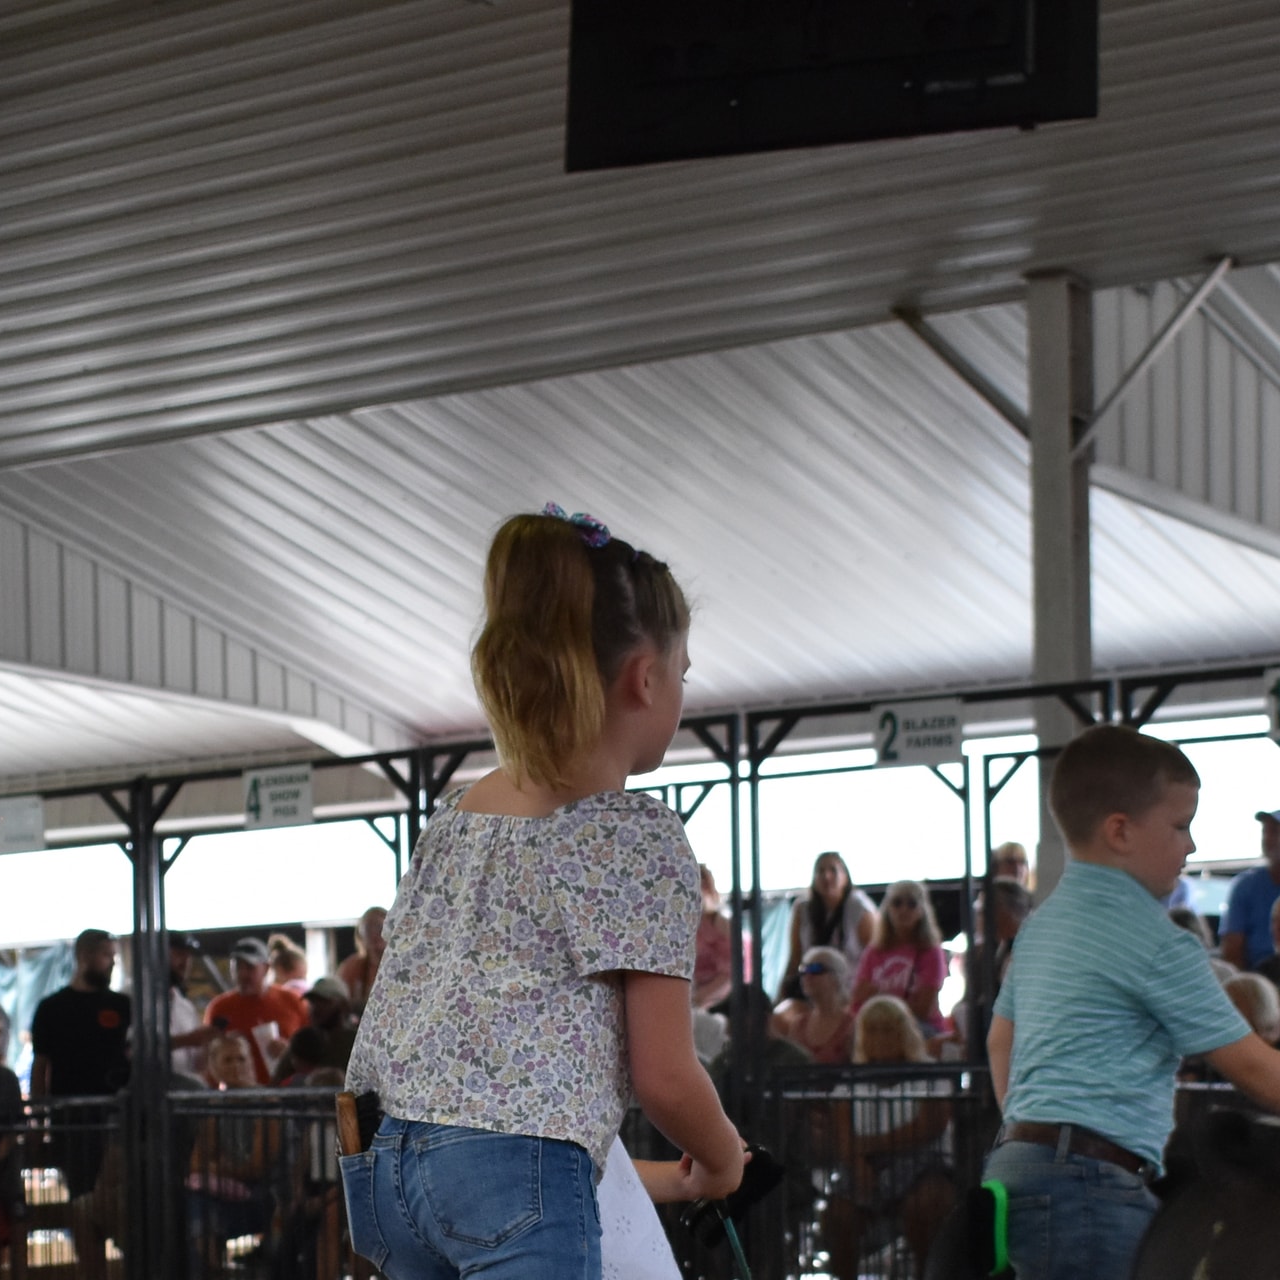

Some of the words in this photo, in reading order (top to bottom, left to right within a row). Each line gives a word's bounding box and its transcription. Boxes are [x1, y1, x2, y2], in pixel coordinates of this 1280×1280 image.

[902, 714, 957, 732] BLAZER
[879, 710, 898, 762] 2
[906, 733, 953, 749] FARMS
[246, 775, 261, 823] 4
[269, 789, 300, 802] SHOW
